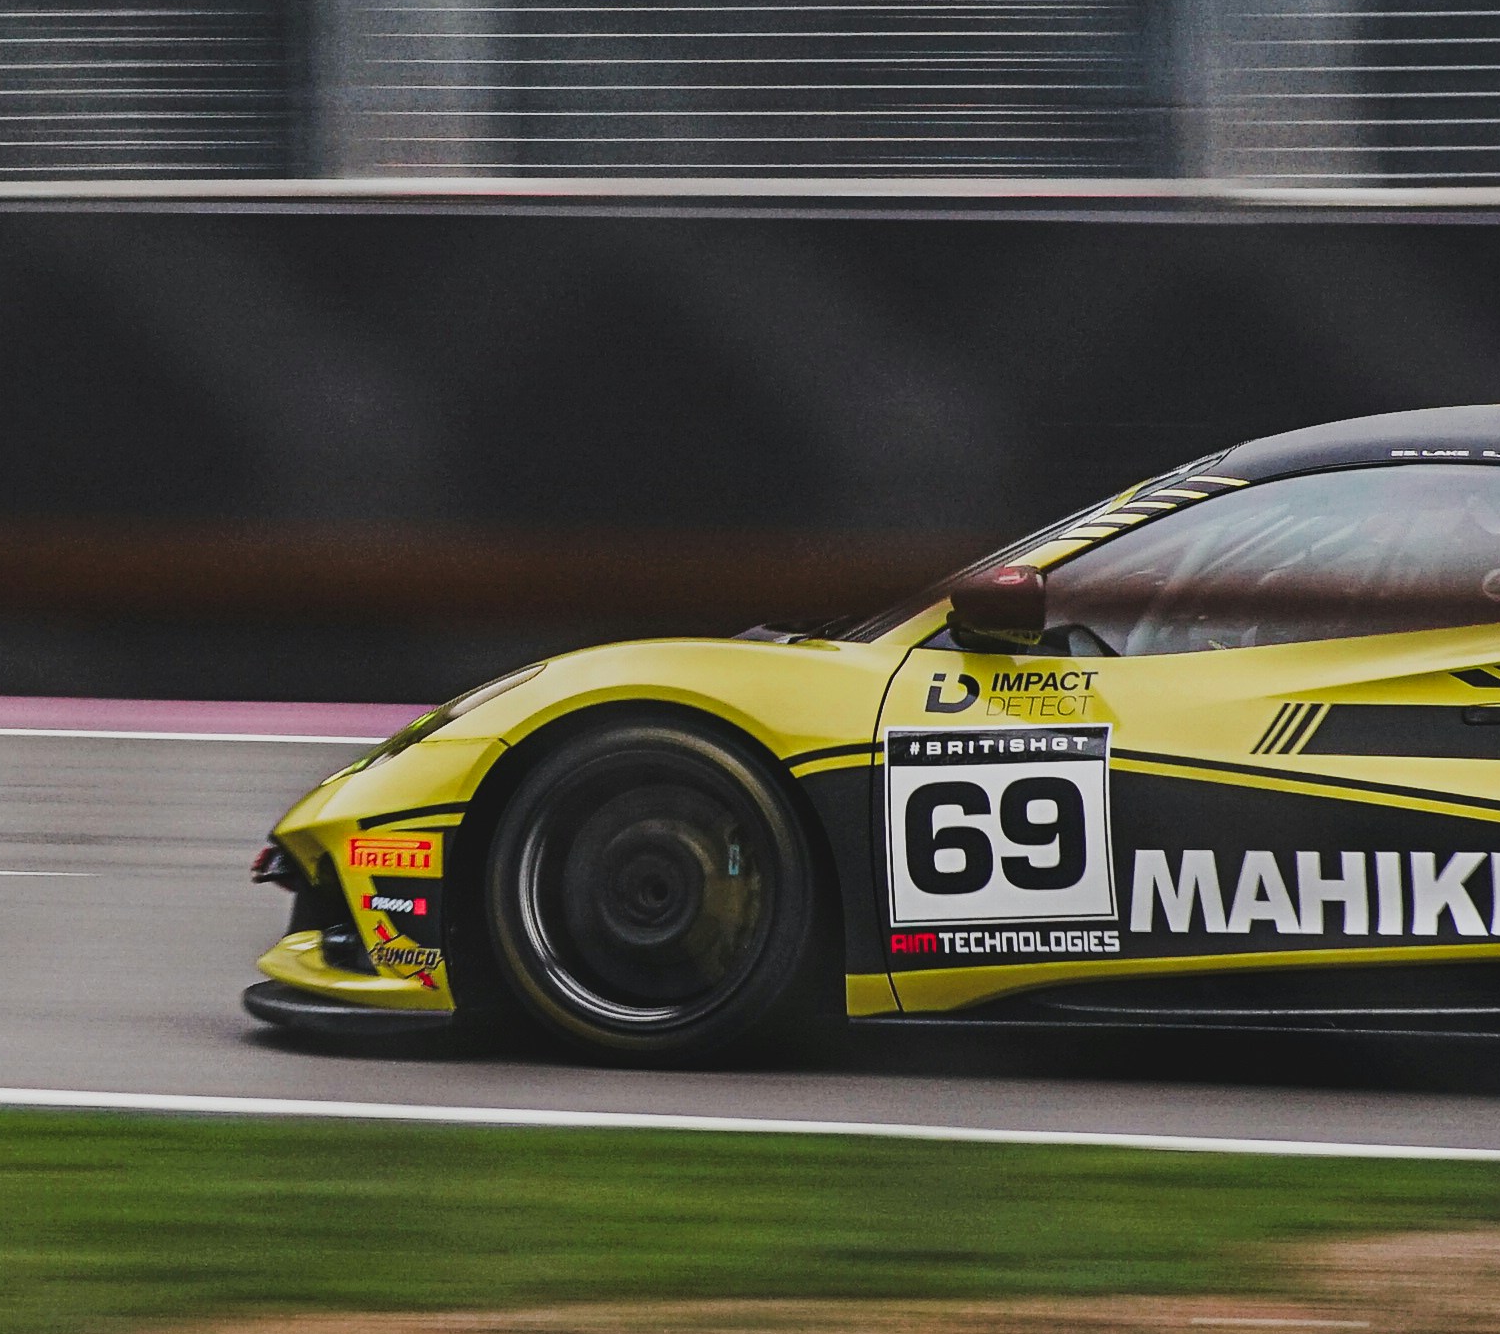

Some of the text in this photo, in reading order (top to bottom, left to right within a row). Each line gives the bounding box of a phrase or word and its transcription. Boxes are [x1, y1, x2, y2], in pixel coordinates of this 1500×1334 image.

[991, 671, 1098, 692] IMPACT
[986, 695, 1094, 717] DETECT
[909, 737, 1089, 756] #BRITISHGT
[905, 776, 1087, 895] 69
[349, 838, 432, 868] PIRELLI
[375, 945, 439, 966] SUNOCO
